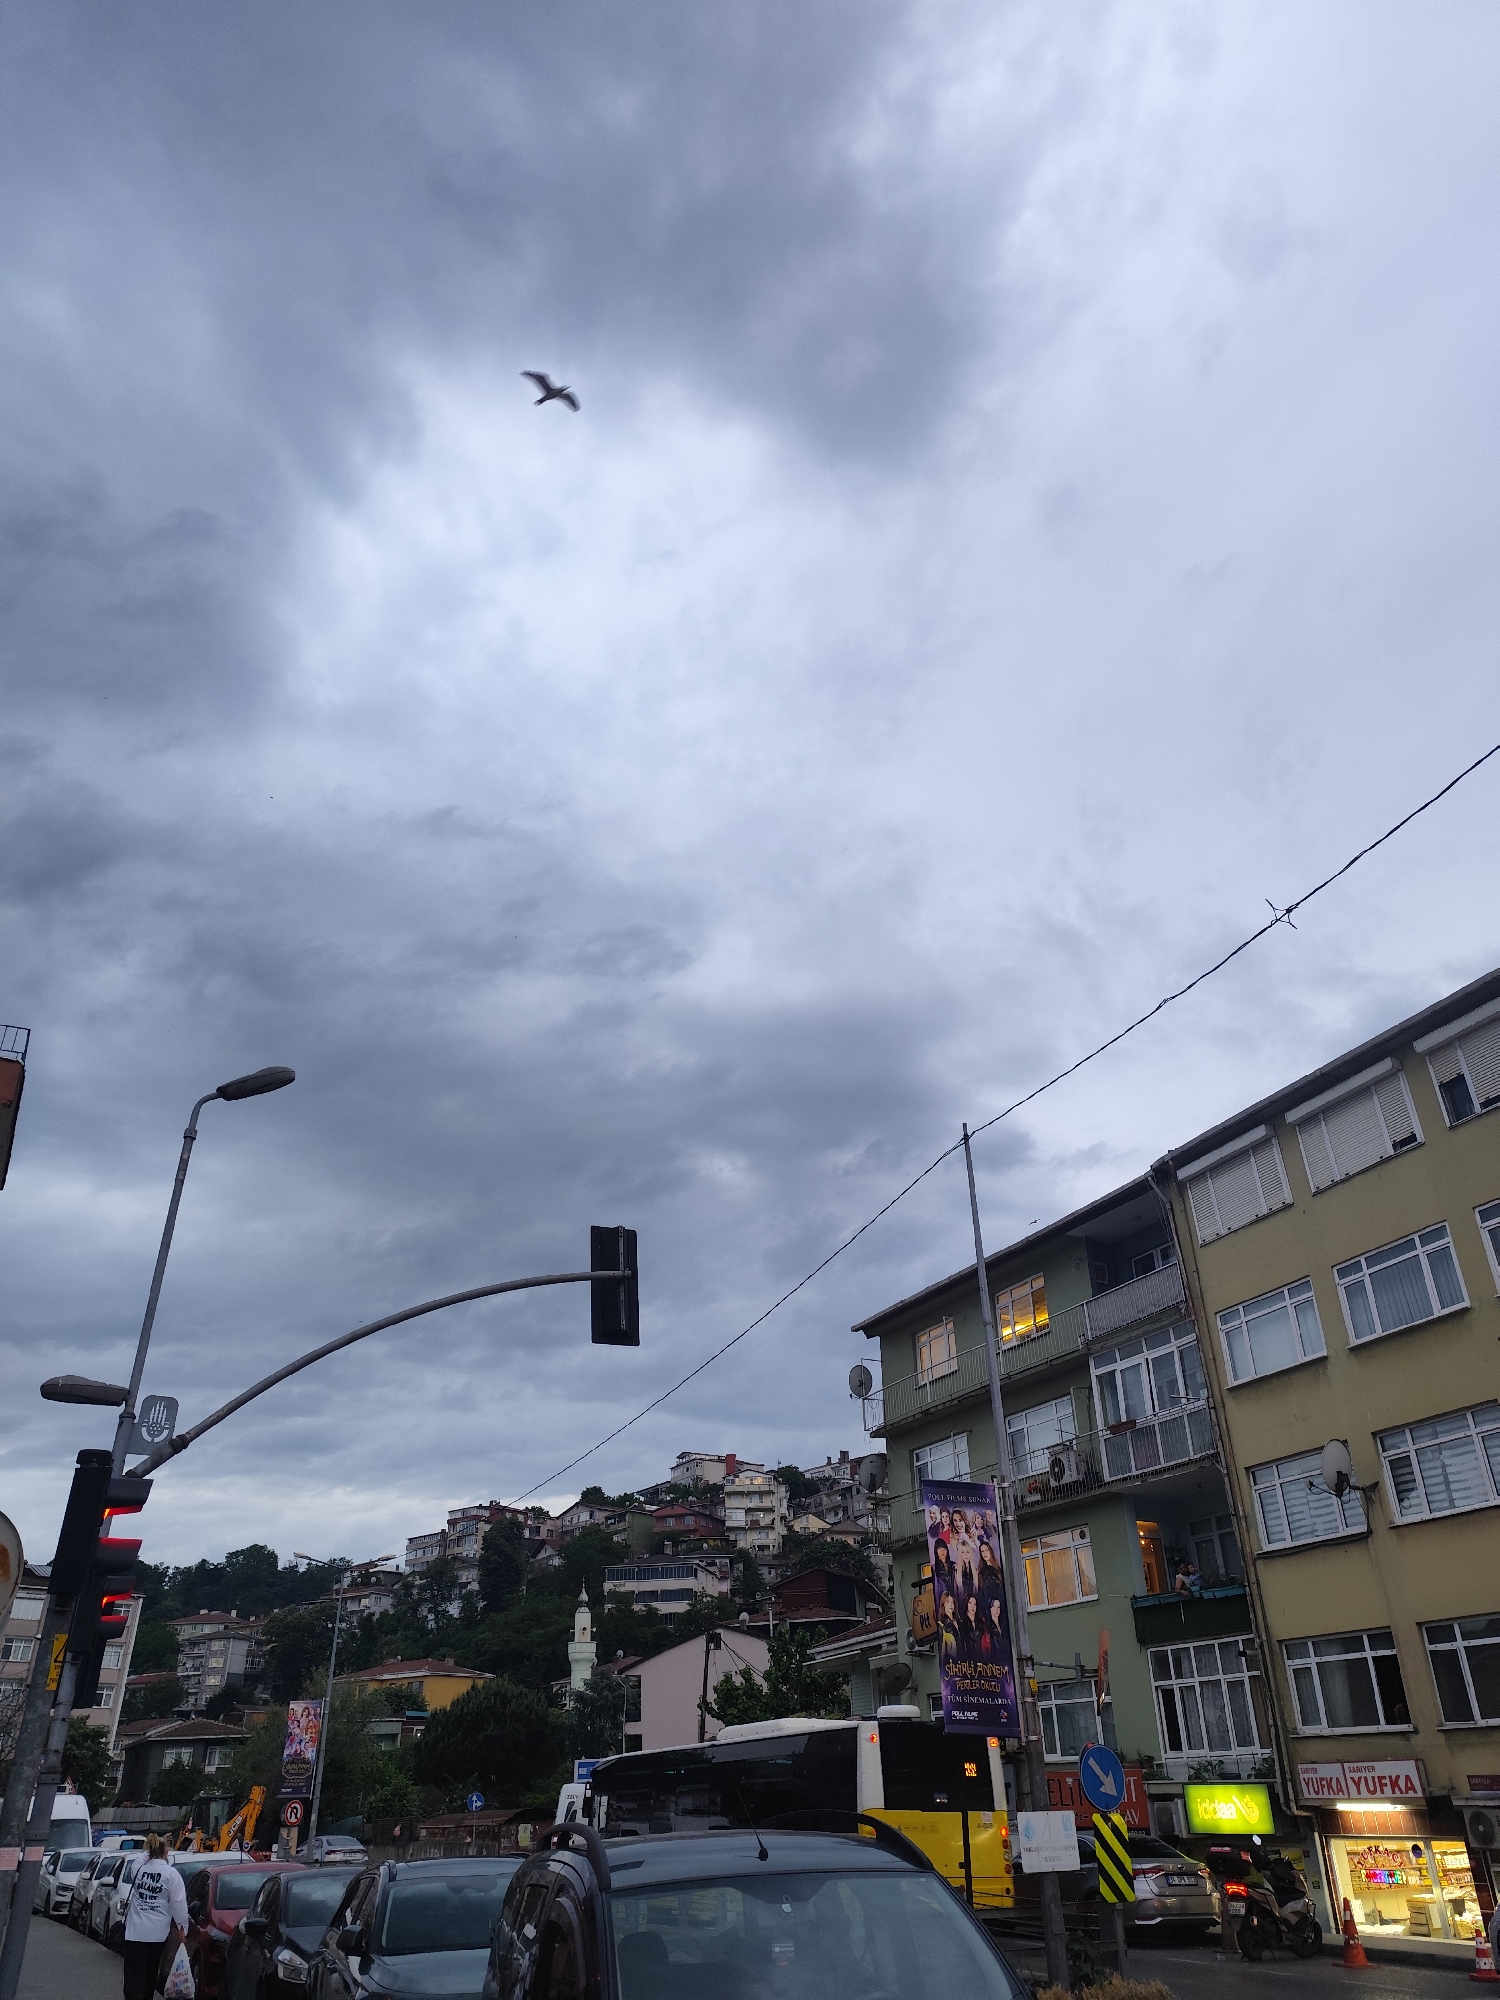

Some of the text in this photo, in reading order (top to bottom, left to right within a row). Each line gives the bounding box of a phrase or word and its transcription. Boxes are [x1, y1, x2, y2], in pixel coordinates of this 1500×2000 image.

[947, 1494, 967, 1502] FILMS
[968, 1496, 991, 1504] SUNAR
[974, 1662, 1010, 1683] ANNEM
[947, 1693, 1012, 1706] TÜM SİNEMALARDA
[1300, 1767, 1319, 1775] SARIYER
[1347, 1765, 1376, 1774] SARIYER
[1302, 1776, 1346, 1796] YUFKA
[1349, 1774, 1418, 1796] YUFKA
[1196, 1798, 1238, 1820] iddaa
[228, 1815, 243, 1837] JCB
[141, 1871, 162, 1884] FIND
